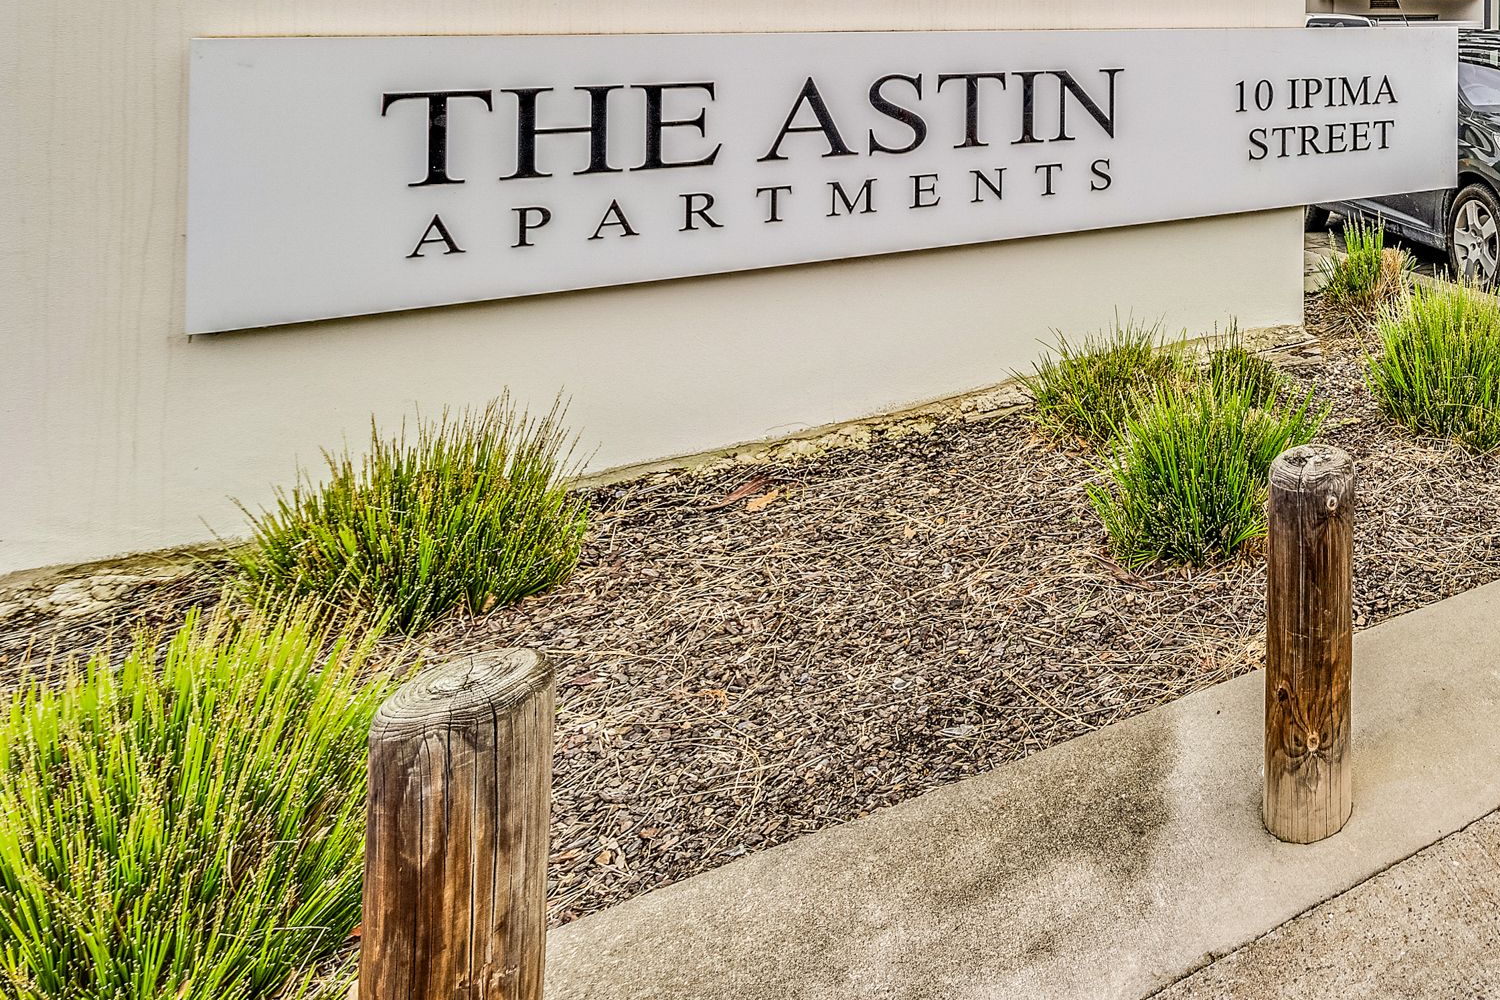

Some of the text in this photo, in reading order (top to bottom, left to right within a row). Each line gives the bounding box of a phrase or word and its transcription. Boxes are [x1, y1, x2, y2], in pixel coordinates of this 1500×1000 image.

[381, 67, 1125, 188] THE ASTIN
[1235, 74, 1399, 114] 10 IPIMA
[1248, 119, 1396, 161] STREET
[405, 158, 1113, 259] APARTMENTS
